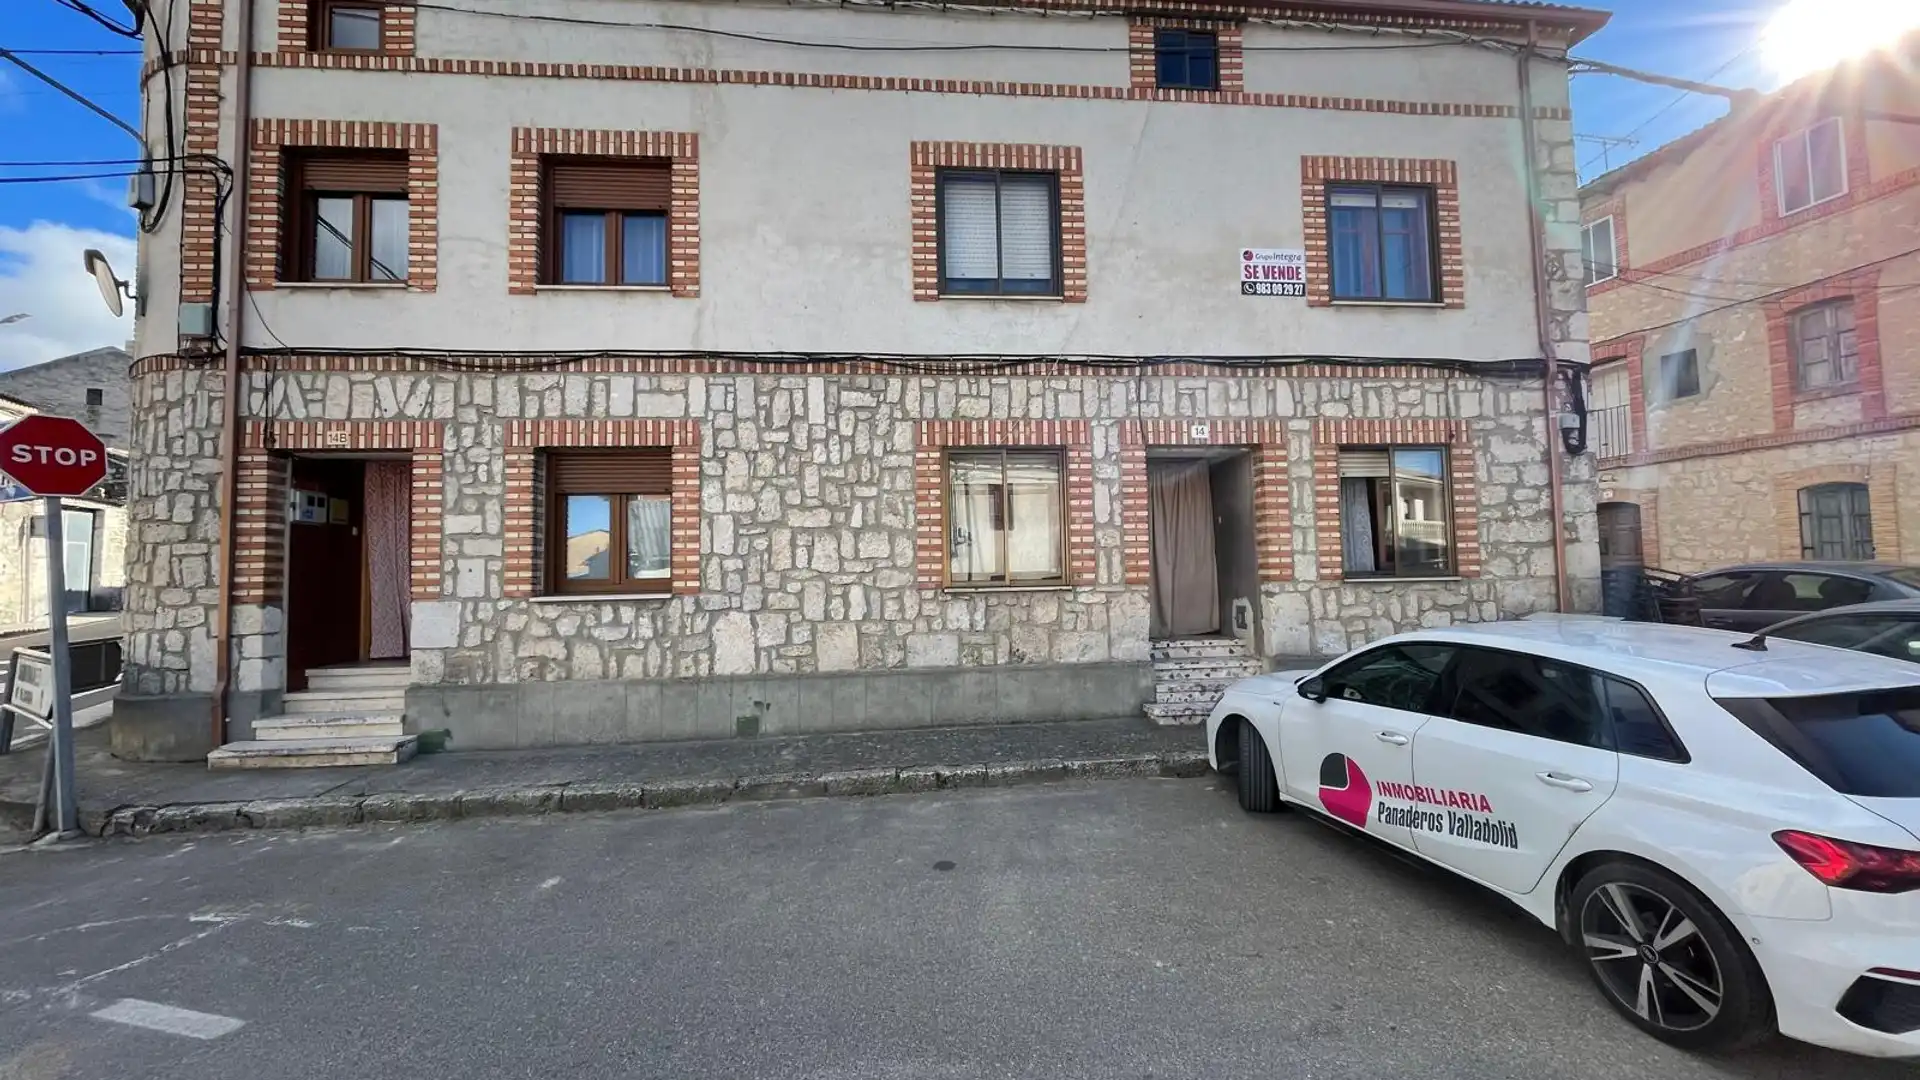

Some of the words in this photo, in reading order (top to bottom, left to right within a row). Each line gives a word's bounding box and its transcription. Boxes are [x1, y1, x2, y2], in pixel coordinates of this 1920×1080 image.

[1273, 252, 1302, 262] Integra
[1244, 264, 1259, 279] SE
[1261, 265, 1302, 281] VENDE
[1256, 282, 1271, 294] 983
[1283, 284, 1294, 295] 29
[1294, 284, 1304, 296] 27
[328, 433, 347, 443] 14B
[11, 444, 97, 467] STOP
[1376, 780, 1493, 814] INMOBILIARIA
[1377, 801, 1444, 833] Panaderos
[1447, 809, 1518, 849] Valladolid
